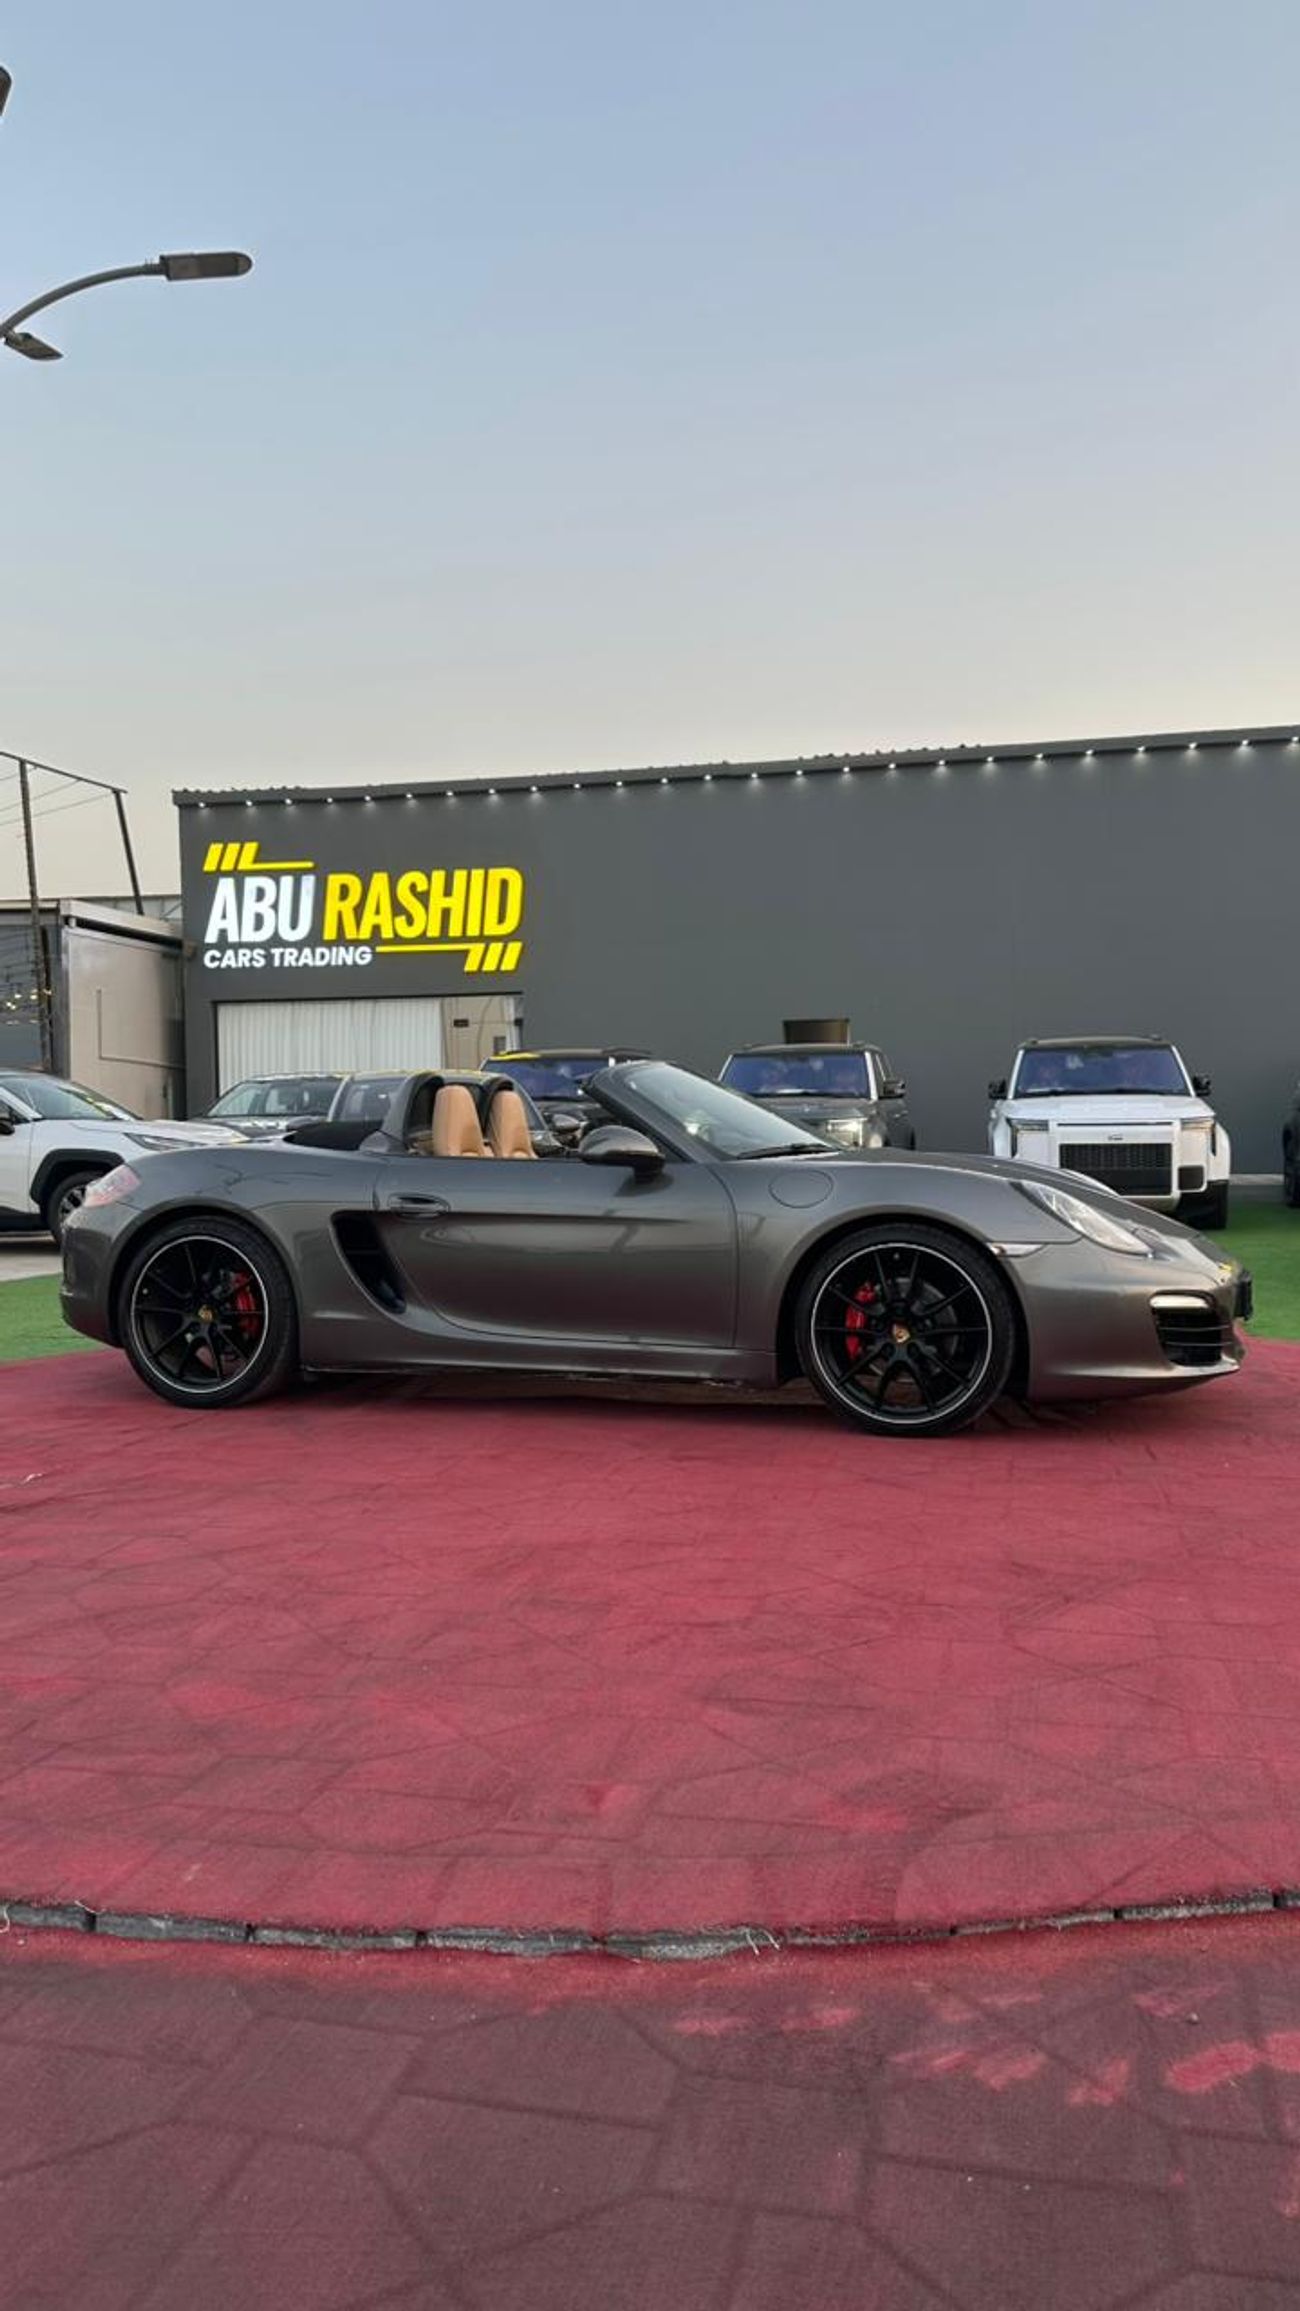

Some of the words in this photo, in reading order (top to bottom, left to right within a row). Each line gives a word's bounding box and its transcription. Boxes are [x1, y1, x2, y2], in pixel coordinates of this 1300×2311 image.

[204, 875, 316, 943] ABU
[323, 867, 523, 941] RASHID
[203, 947, 266, 969] CARS
[270, 945, 373, 967] TRADING
